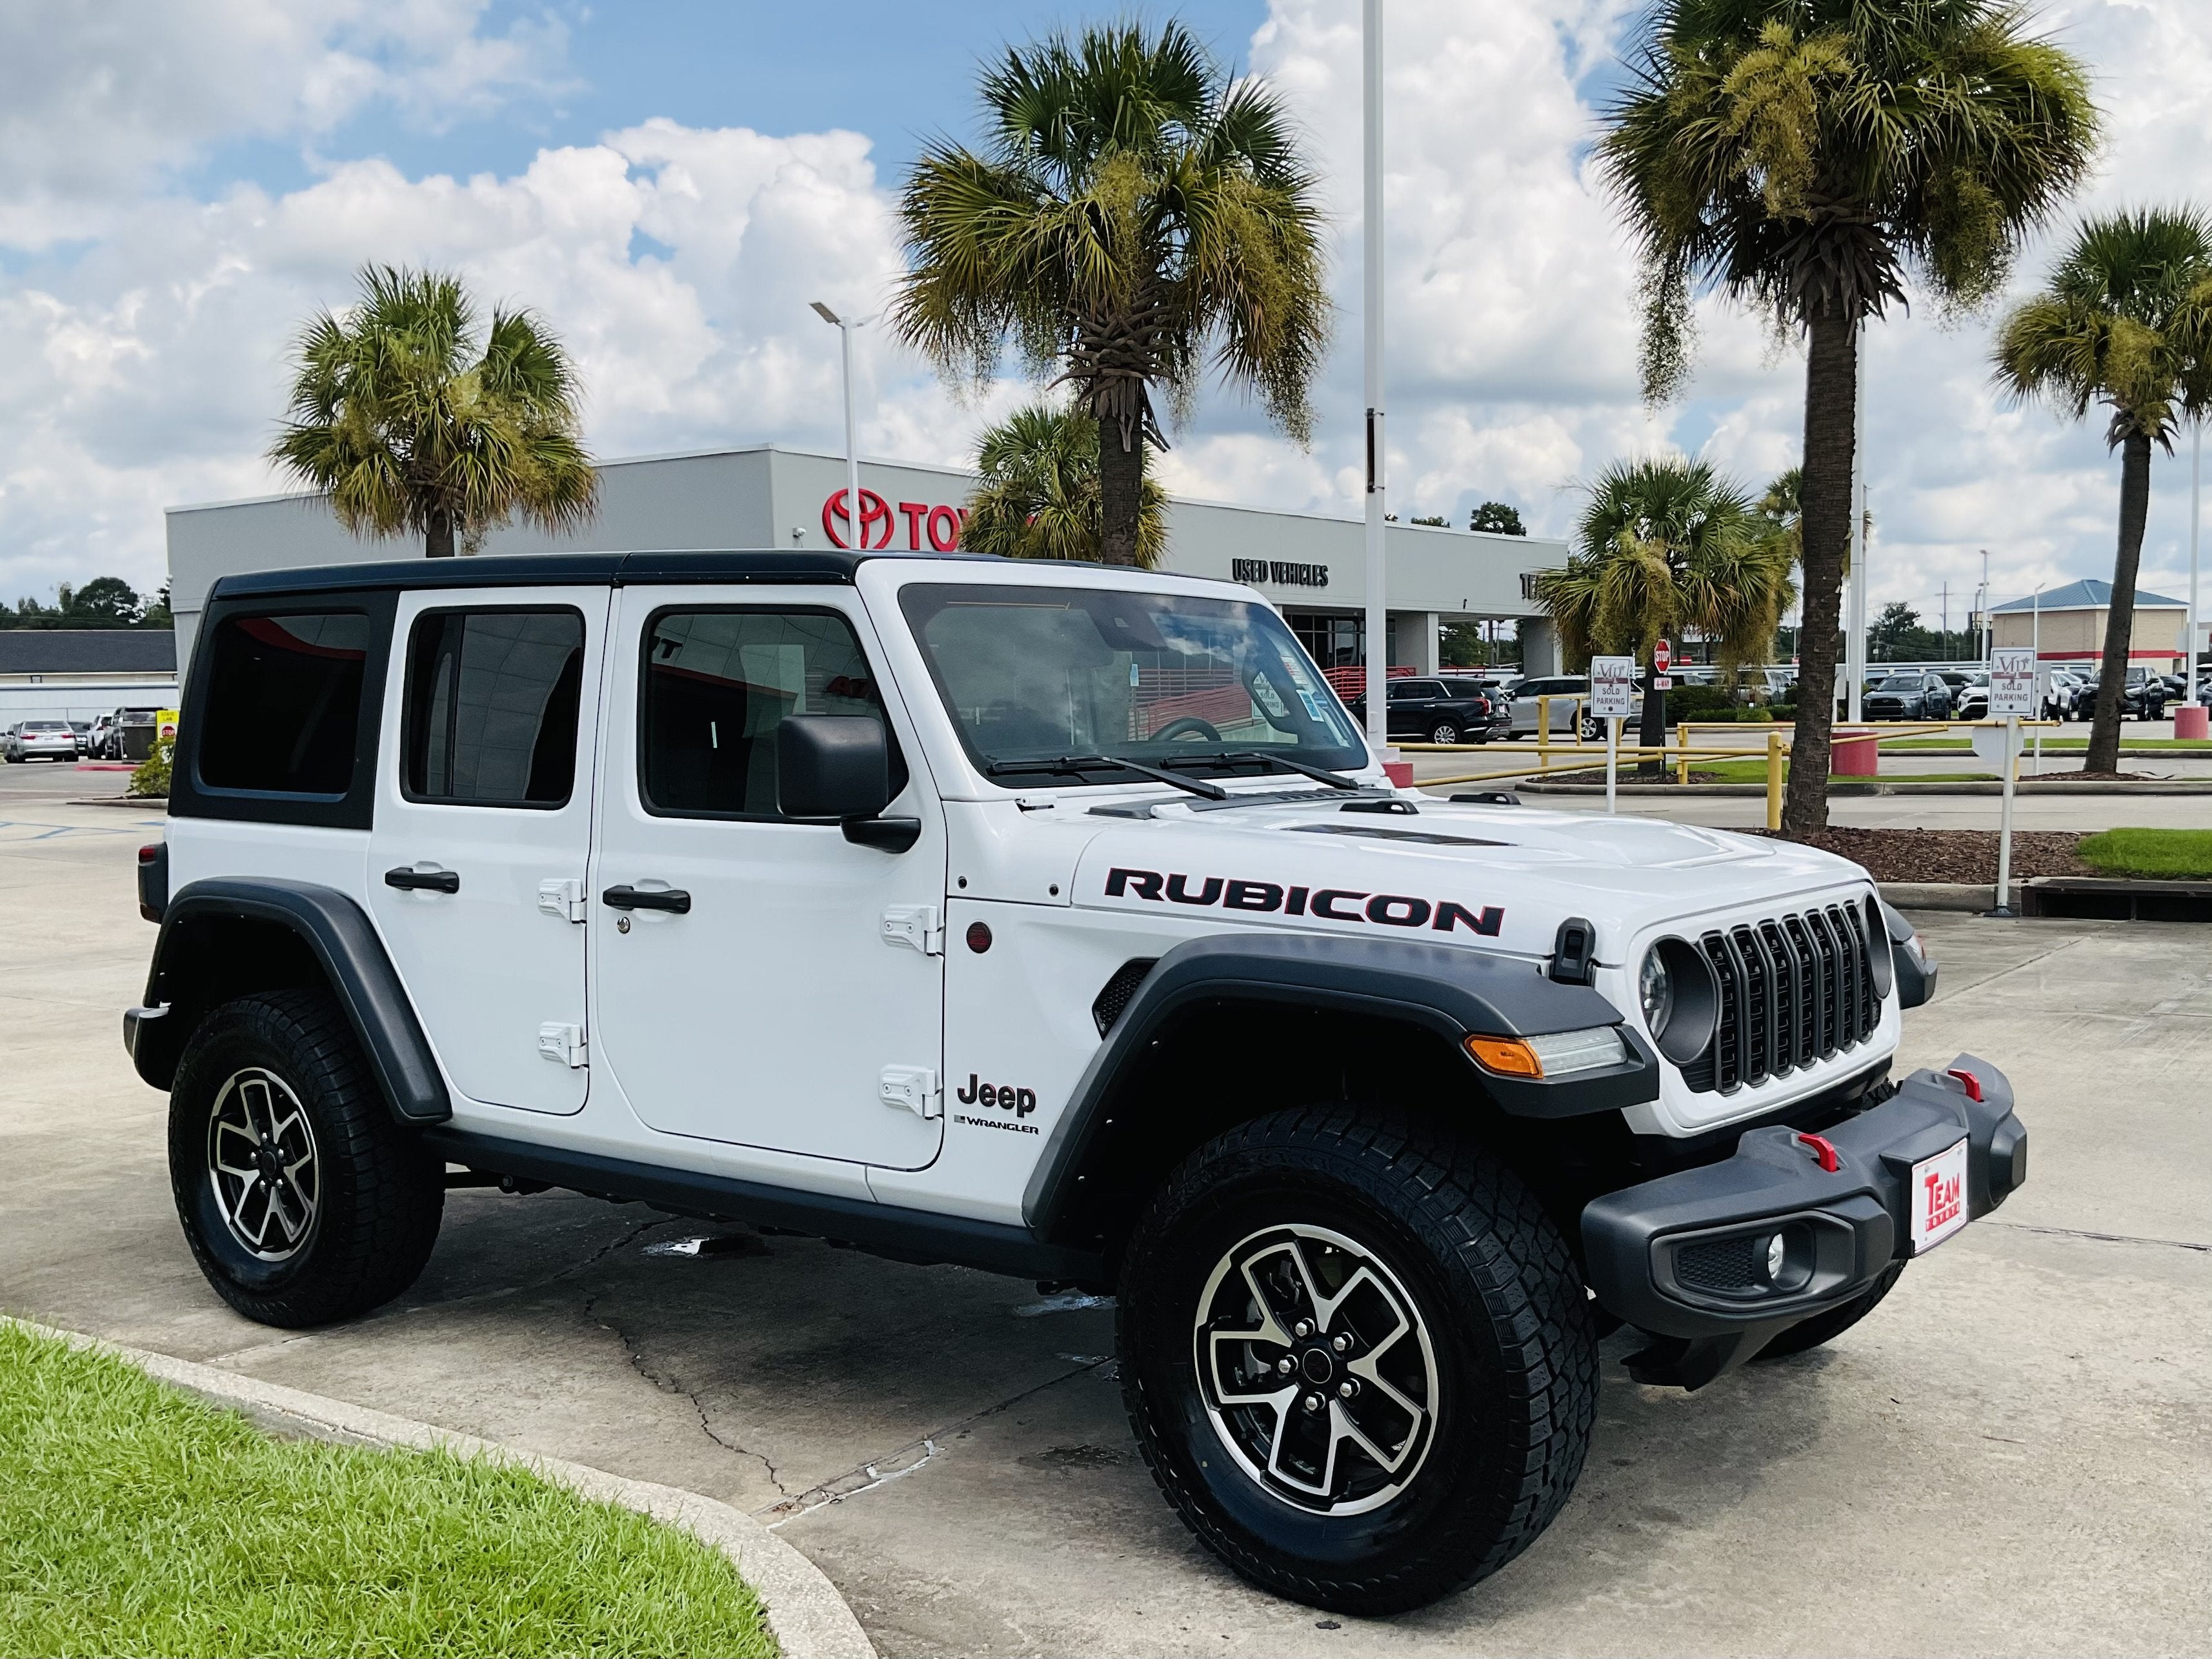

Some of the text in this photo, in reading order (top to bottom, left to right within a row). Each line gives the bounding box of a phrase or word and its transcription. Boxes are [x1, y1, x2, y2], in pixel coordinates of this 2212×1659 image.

[1232, 558, 1328, 586] USED VEHICLES
[1655, 650, 1669, 662] STOP
[1994, 693, 2028, 701] PARKING
[1104, 867, 1505, 937] RUBICON
[957, 1073, 1036, 1118] Jeep
[966, 1116, 1039, 1134] WRANGLER
[1924, 1172, 1960, 1216] TEAM
[1925, 1203, 1960, 1231] TOYOTA
